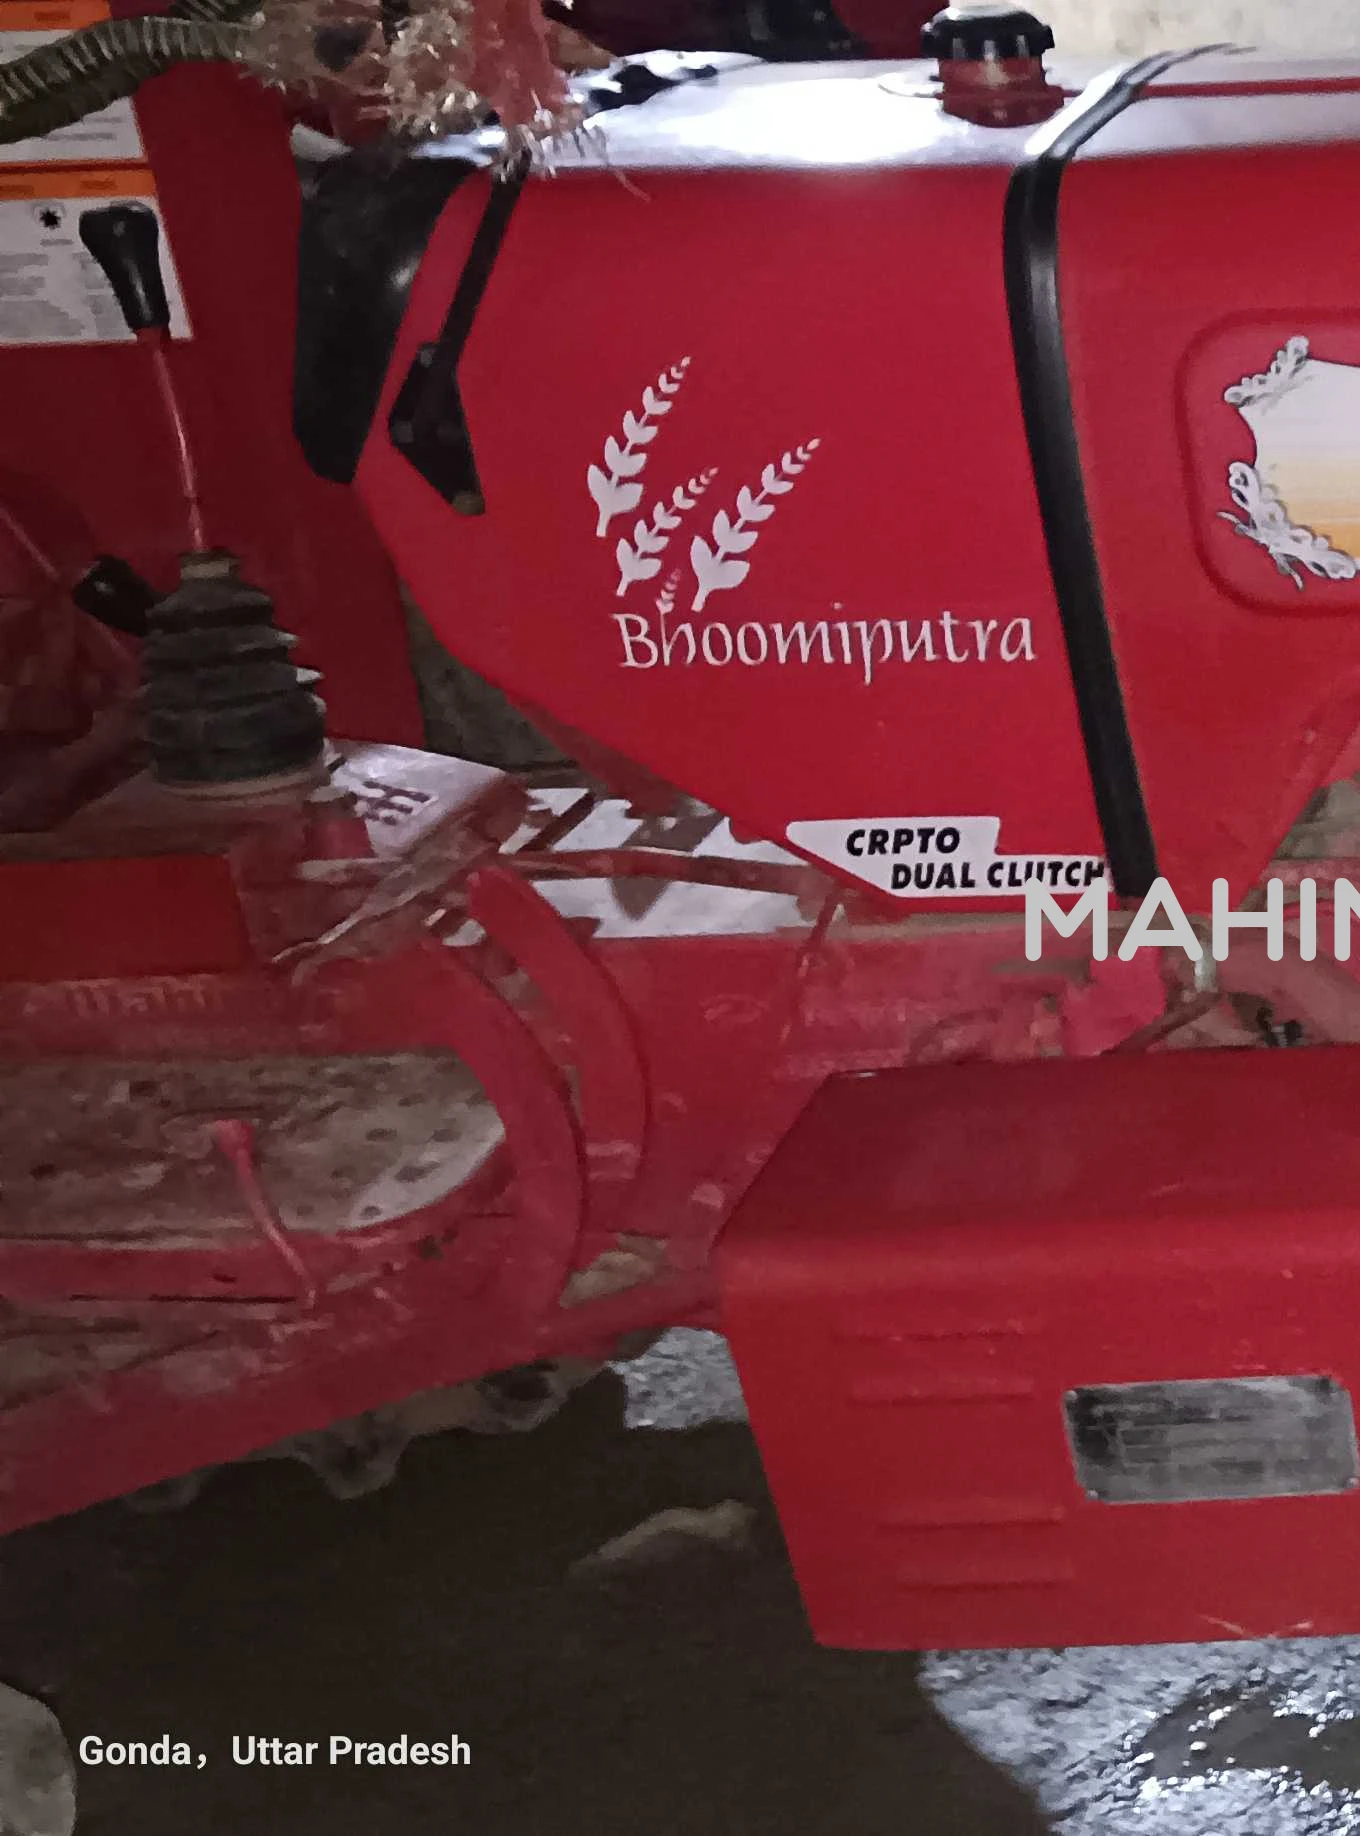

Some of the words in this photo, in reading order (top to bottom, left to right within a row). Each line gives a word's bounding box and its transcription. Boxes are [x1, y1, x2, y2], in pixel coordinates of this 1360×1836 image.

[610, 602, 1036, 686] Bhoomiputra
[846, 826, 960, 857] CRPTO
[890, 862, 976, 890] DUAL
